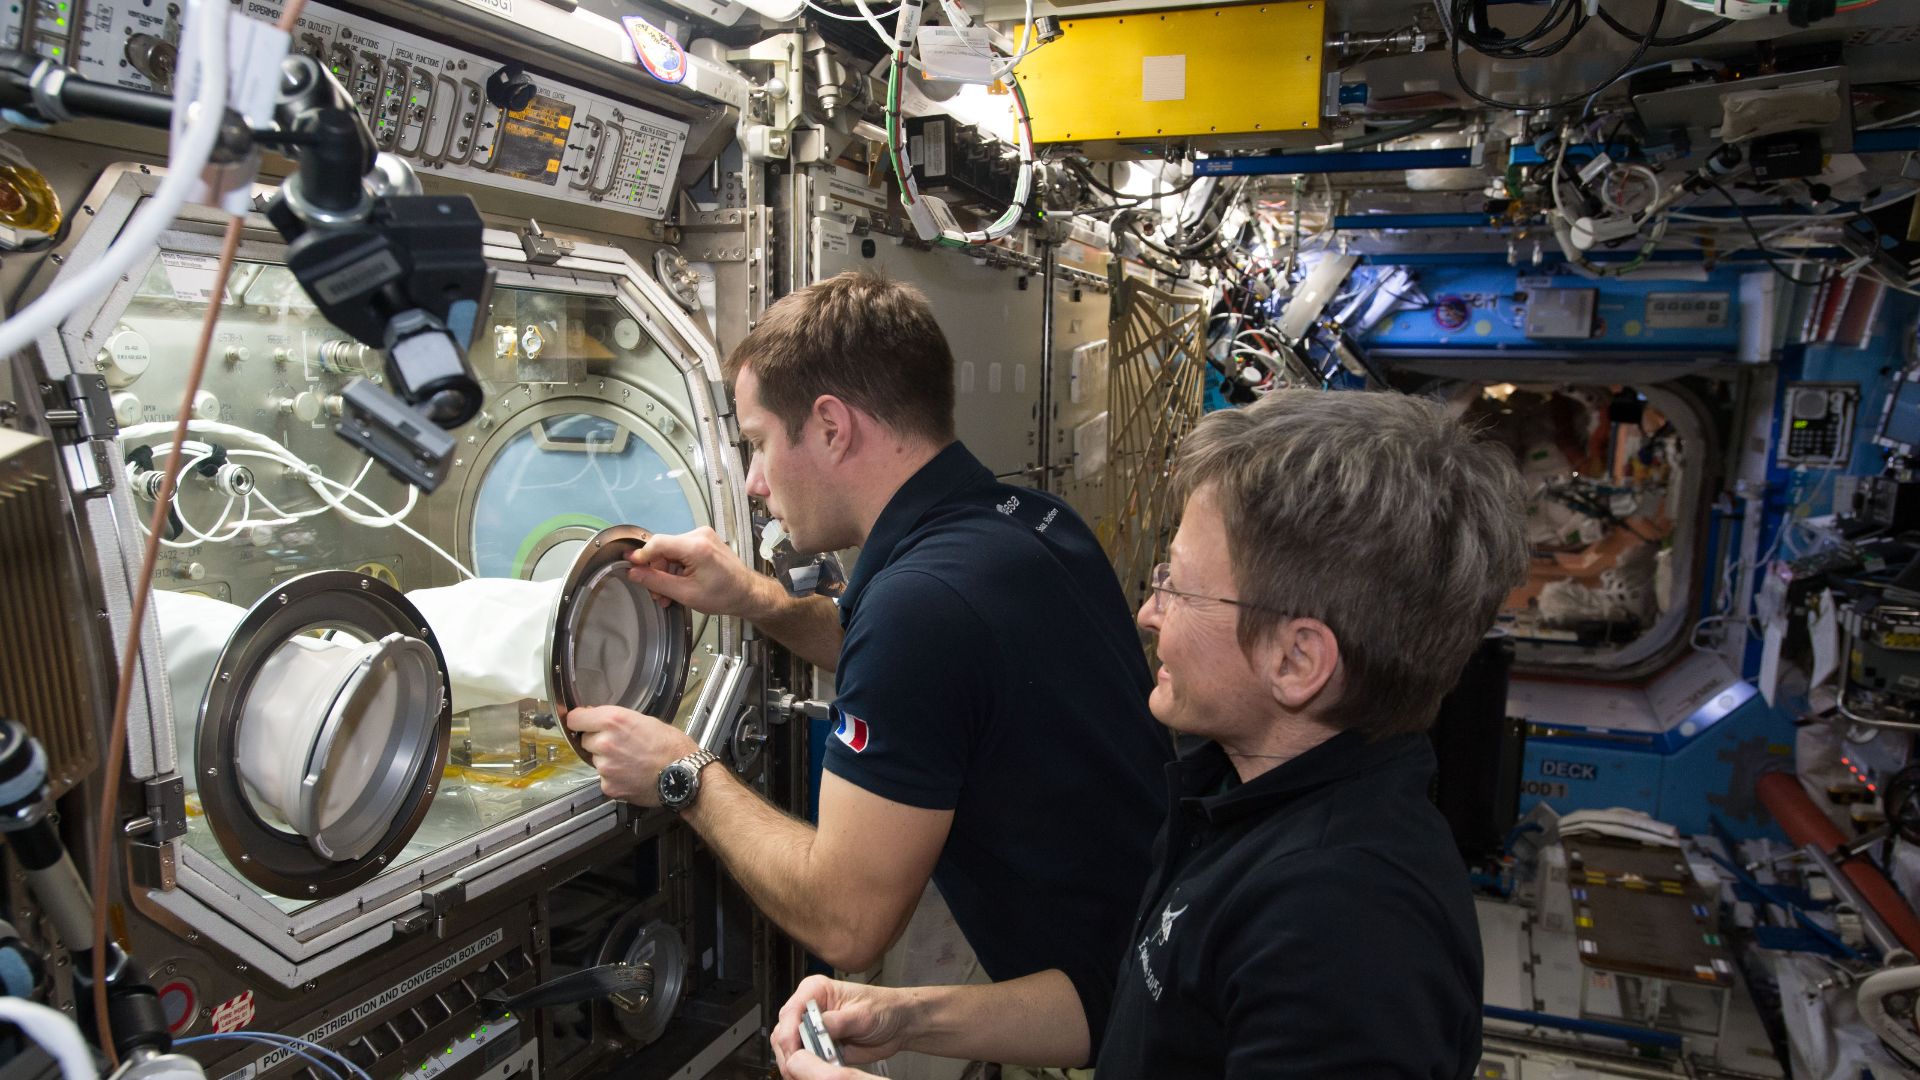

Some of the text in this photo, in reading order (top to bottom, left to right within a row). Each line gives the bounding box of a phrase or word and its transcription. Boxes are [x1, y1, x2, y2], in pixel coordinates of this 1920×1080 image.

[248, 2, 281, 21] EXPERIMEN
[308, 21, 332, 36] OUTLETS
[352, 34, 380, 50] FUNCTIONS
[395, 47, 415, 62] SPECIAL
[415, 53, 440, 68] FUNCTIONS
[1000, 496, 1020, 515] esa
[1543, 760, 1595, 779] DECK
[307, 1000, 377, 1043] DISTRIBUTION
[379, 987, 399, 1008] AND
[400, 956, 457, 993] CONVERSION
[459, 946, 476, 961] BOX
[477, 932, 499, 952] (PDC)
